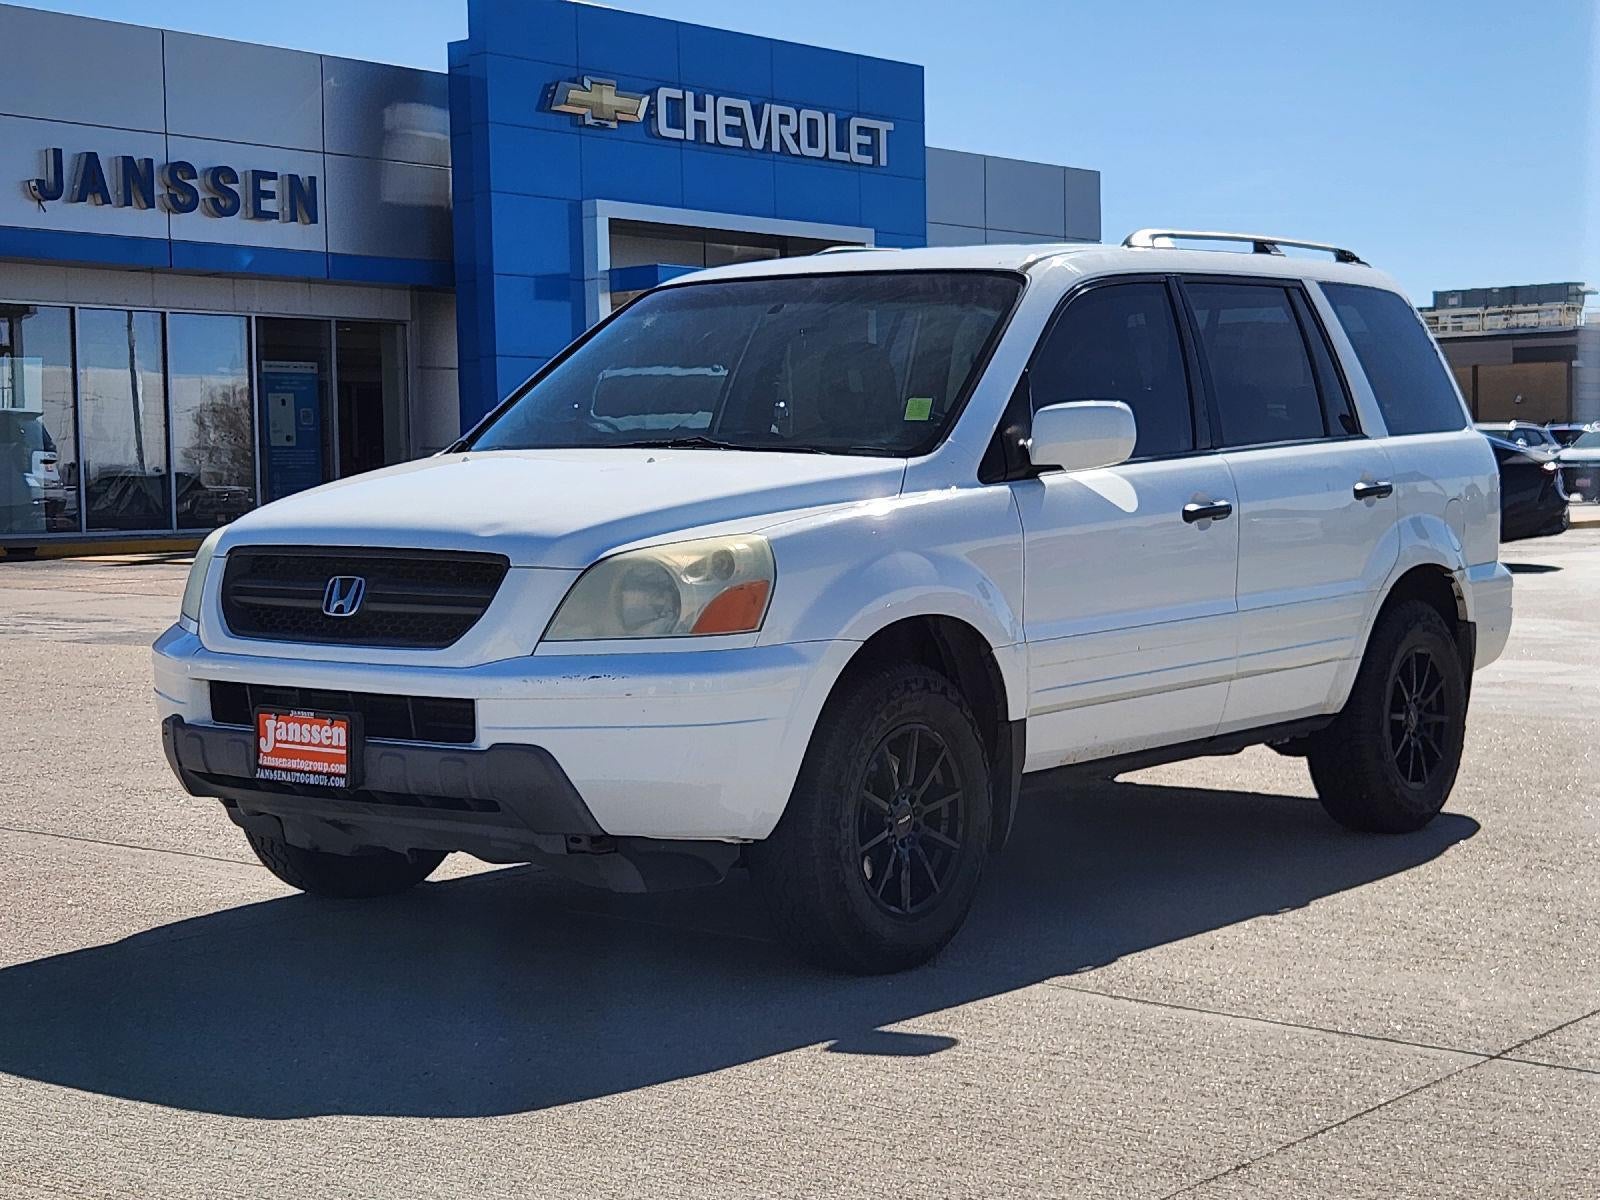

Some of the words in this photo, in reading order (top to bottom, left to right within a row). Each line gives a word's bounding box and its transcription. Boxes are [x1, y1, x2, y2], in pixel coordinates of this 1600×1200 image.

[657, 87, 894, 167] CHEVROLET
[25, 148, 318, 225] JANSSEN
[260, 719, 346, 753] Janssen
[256, 768, 346, 788] JANSSENAUTOGROUP.COM
[259, 753, 347, 774] Janssenautogroup.com
